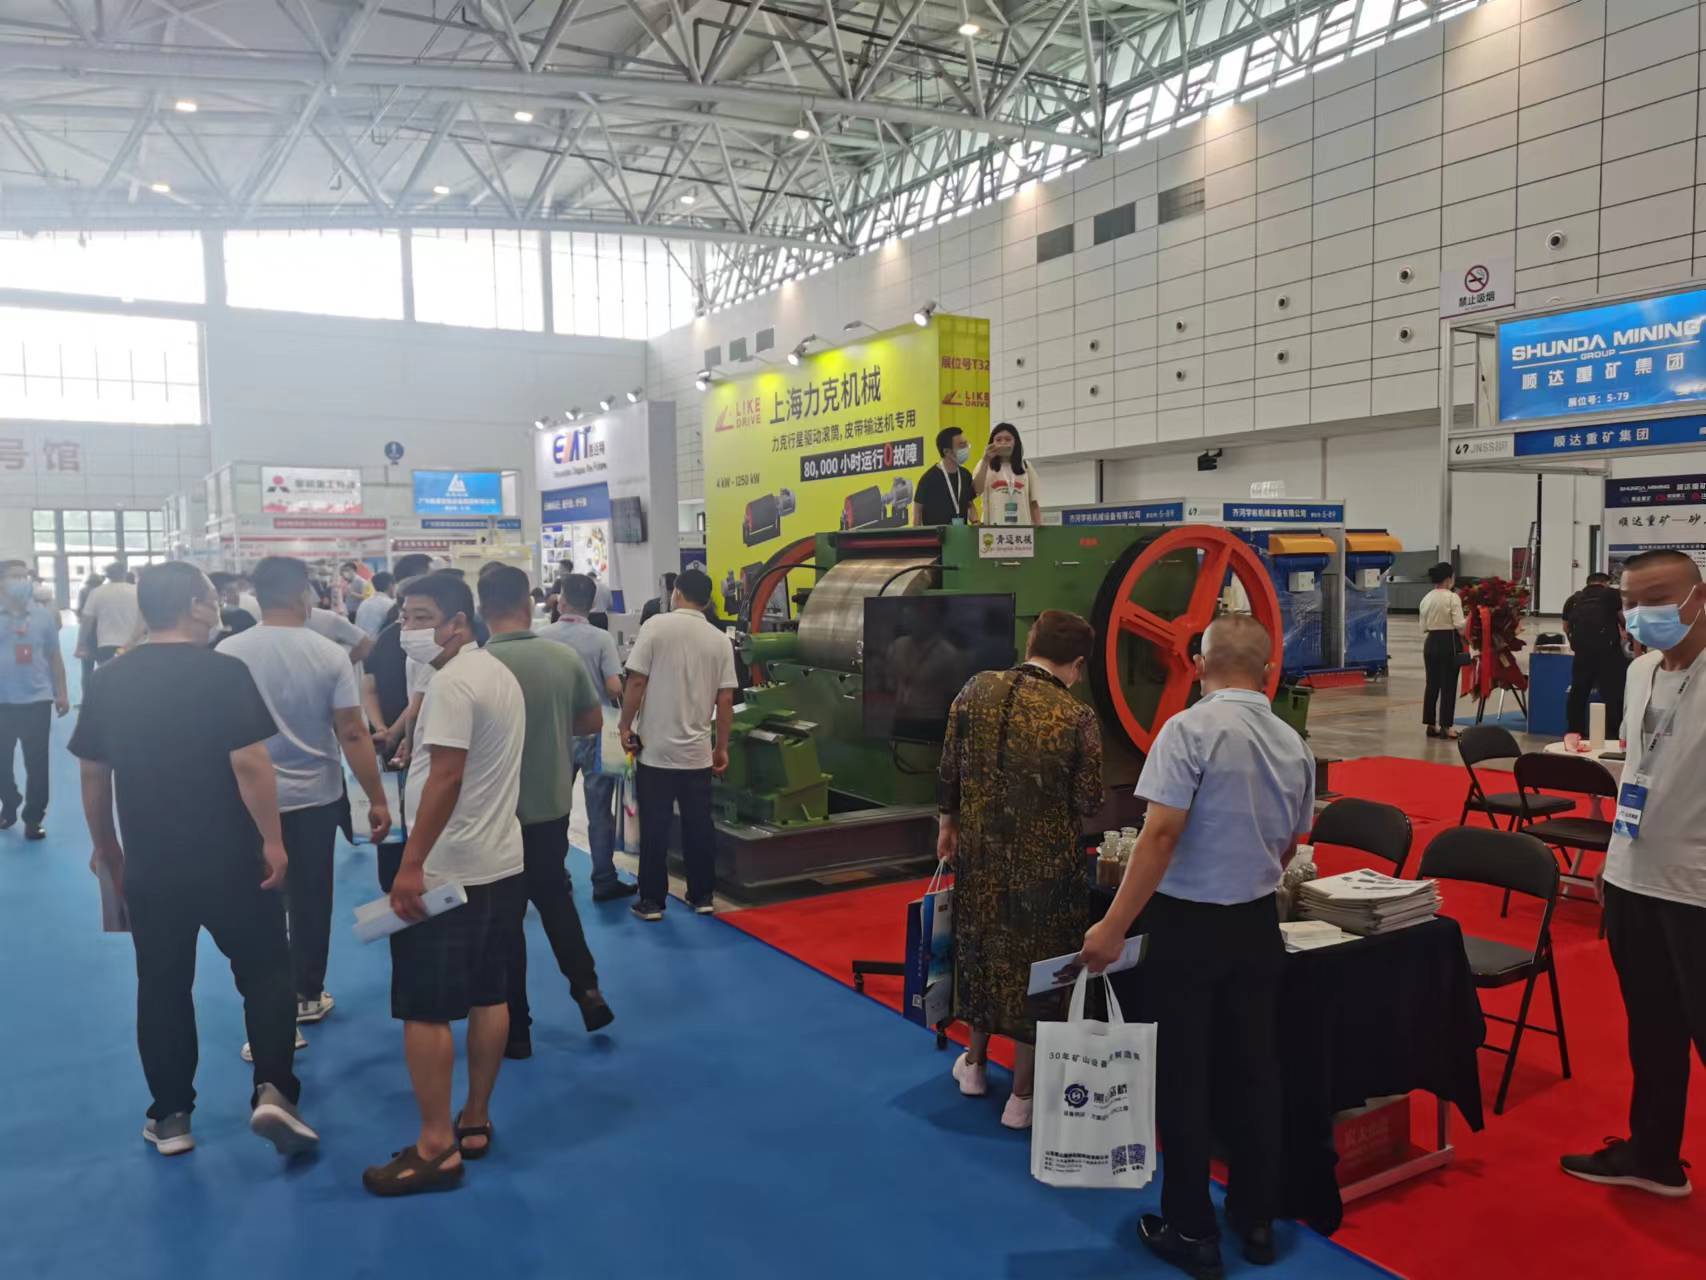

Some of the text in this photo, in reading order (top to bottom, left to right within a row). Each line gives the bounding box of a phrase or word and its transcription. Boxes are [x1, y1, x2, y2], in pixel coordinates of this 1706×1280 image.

[1458, 290, 1496, 307] 禁止吸烟
[1512, 319, 1701, 362] SHUNDA MINING
[941, 356, 990, 371] 展位号T32
[1580, 349, 1616, 361] GROUP
[1521, 352, 1684, 390] 顺达重矿集团
[769, 365, 882, 424] 上海力克机械
[965, 391, 990, 401] LIKE
[1606, 392, 1630, 403] 5-79
[735, 397, 761, 417] LIKE
[735, 413, 761, 429] DRIVE
[1553, 428, 1650, 448] 顺达重矿集团
